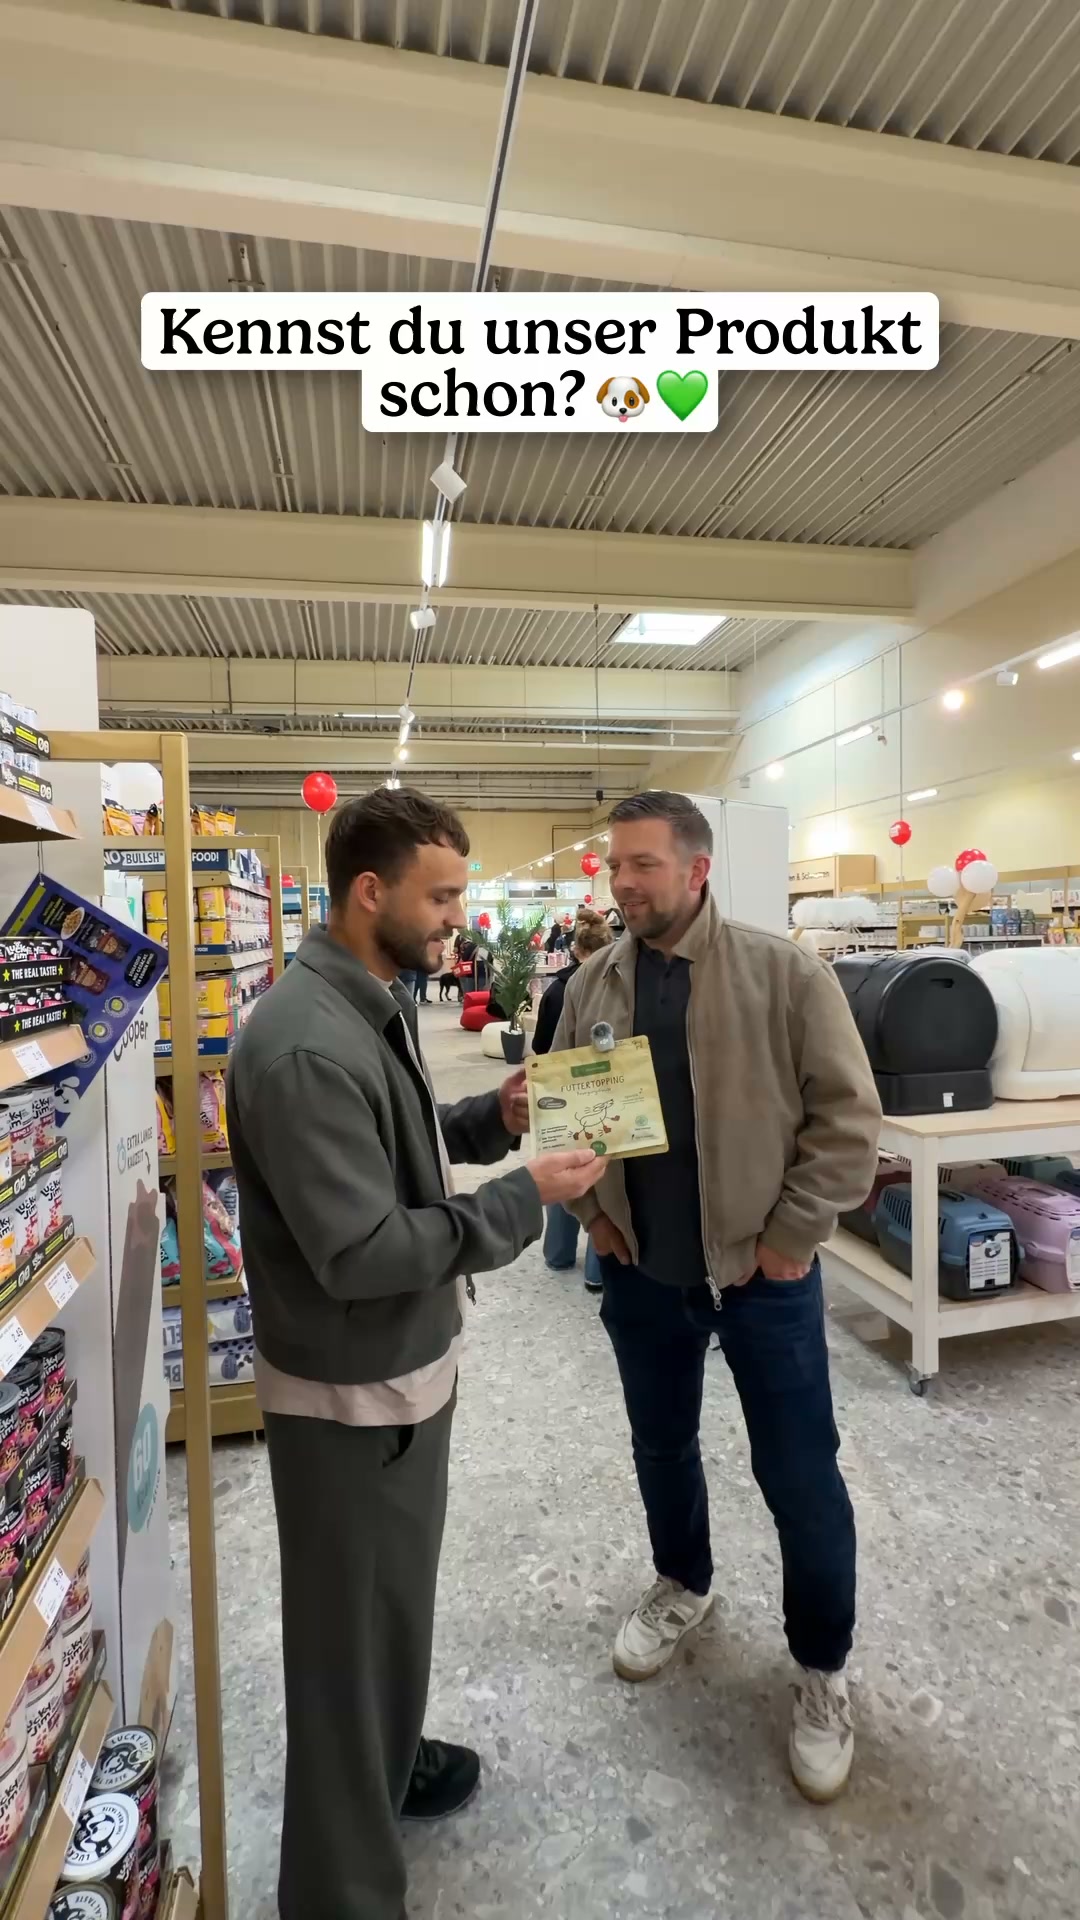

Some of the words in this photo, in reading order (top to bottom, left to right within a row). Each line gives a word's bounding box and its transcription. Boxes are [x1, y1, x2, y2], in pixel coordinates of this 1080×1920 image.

[11, 968, 23, 980] THE
[24, 967, 39, 979] REAL
[40, 965, 58, 977] TASTE!
[22, 1018, 31, 1029] THE
[32, 1015, 46, 1027] REAL
[46, 1010, 62, 1023] TASTE!
[561, 1075, 625, 1093] FUTTERTOPPING
[111, 1733, 144, 1745] LUCKY
